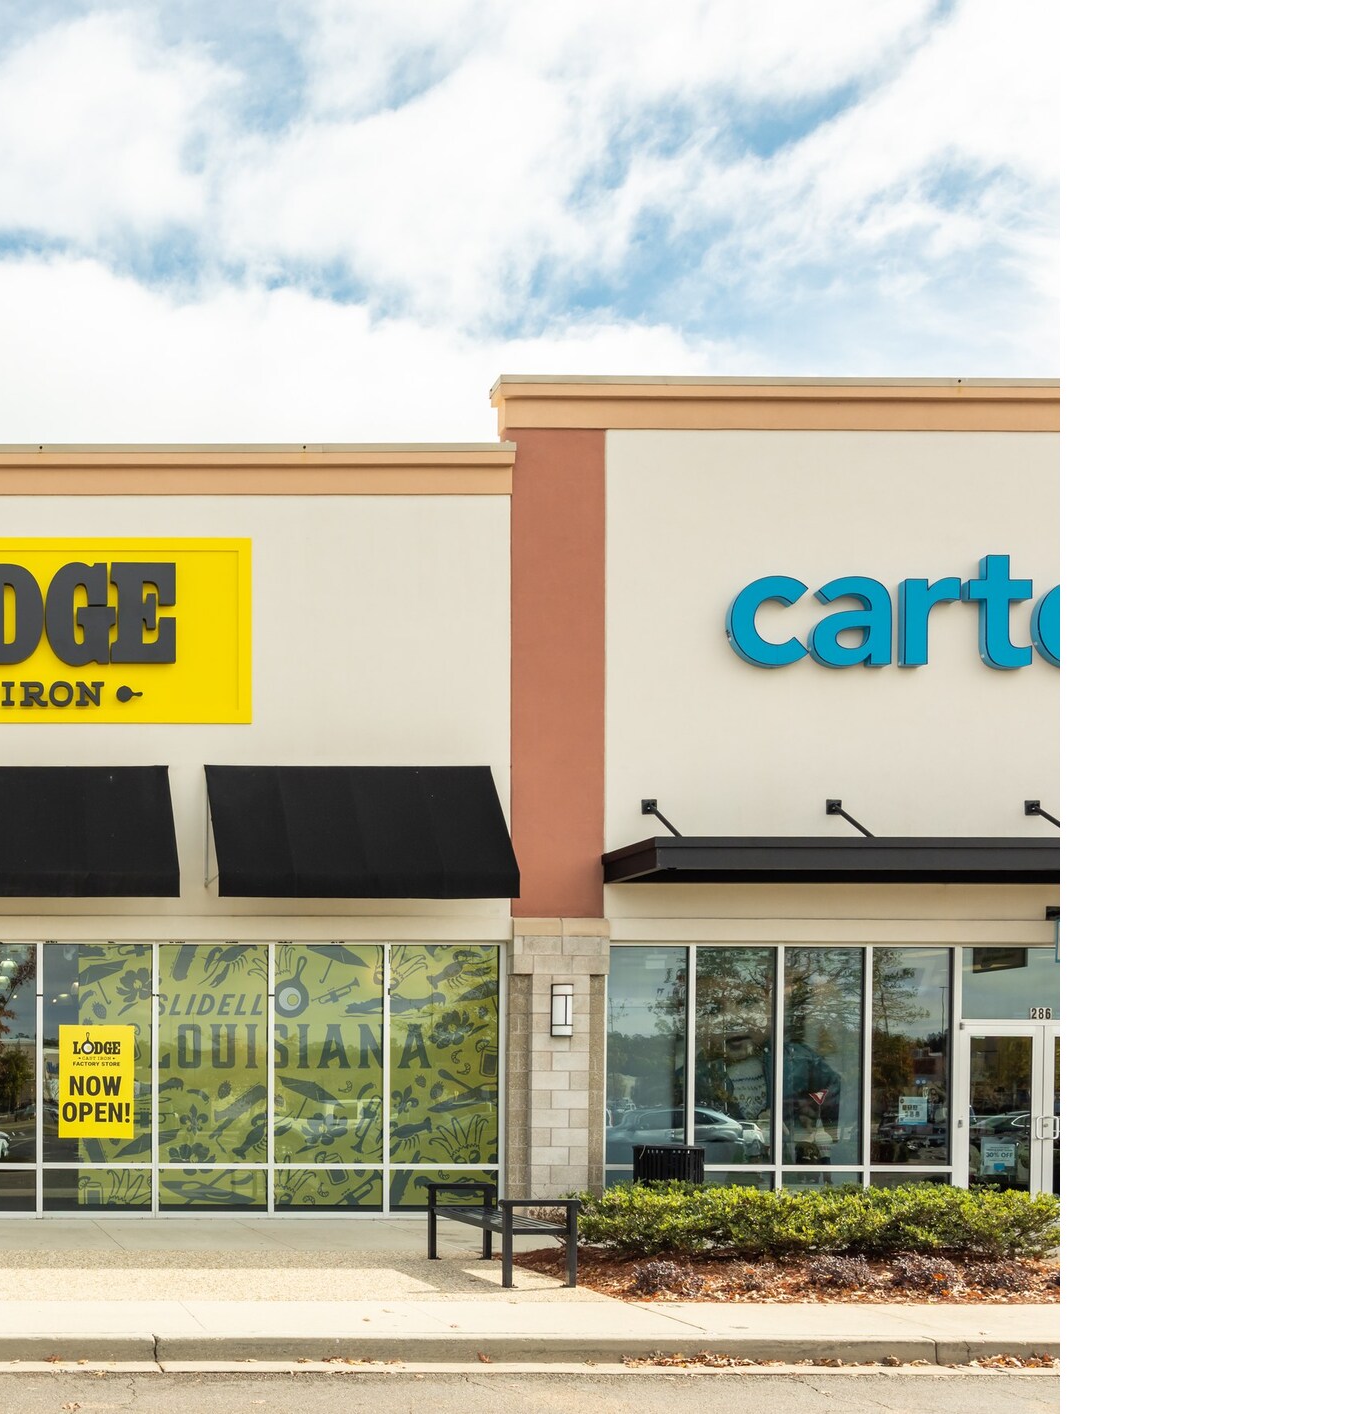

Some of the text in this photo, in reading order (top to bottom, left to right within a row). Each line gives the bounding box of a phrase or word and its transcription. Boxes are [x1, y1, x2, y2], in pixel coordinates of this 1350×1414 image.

[725, 554, 1060, 671] cart
[1, 680, 105, 708] IRON
[158, 993, 263, 1016] SLIDELL
[1031, 1007, 1052, 1020] 286
[72, 1041, 121, 1055] LODGE
[147, 1023, 432, 1069] LOUISIANA
[69, 1075, 122, 1096] NOW
[62, 1101, 130, 1123] OPEN!
